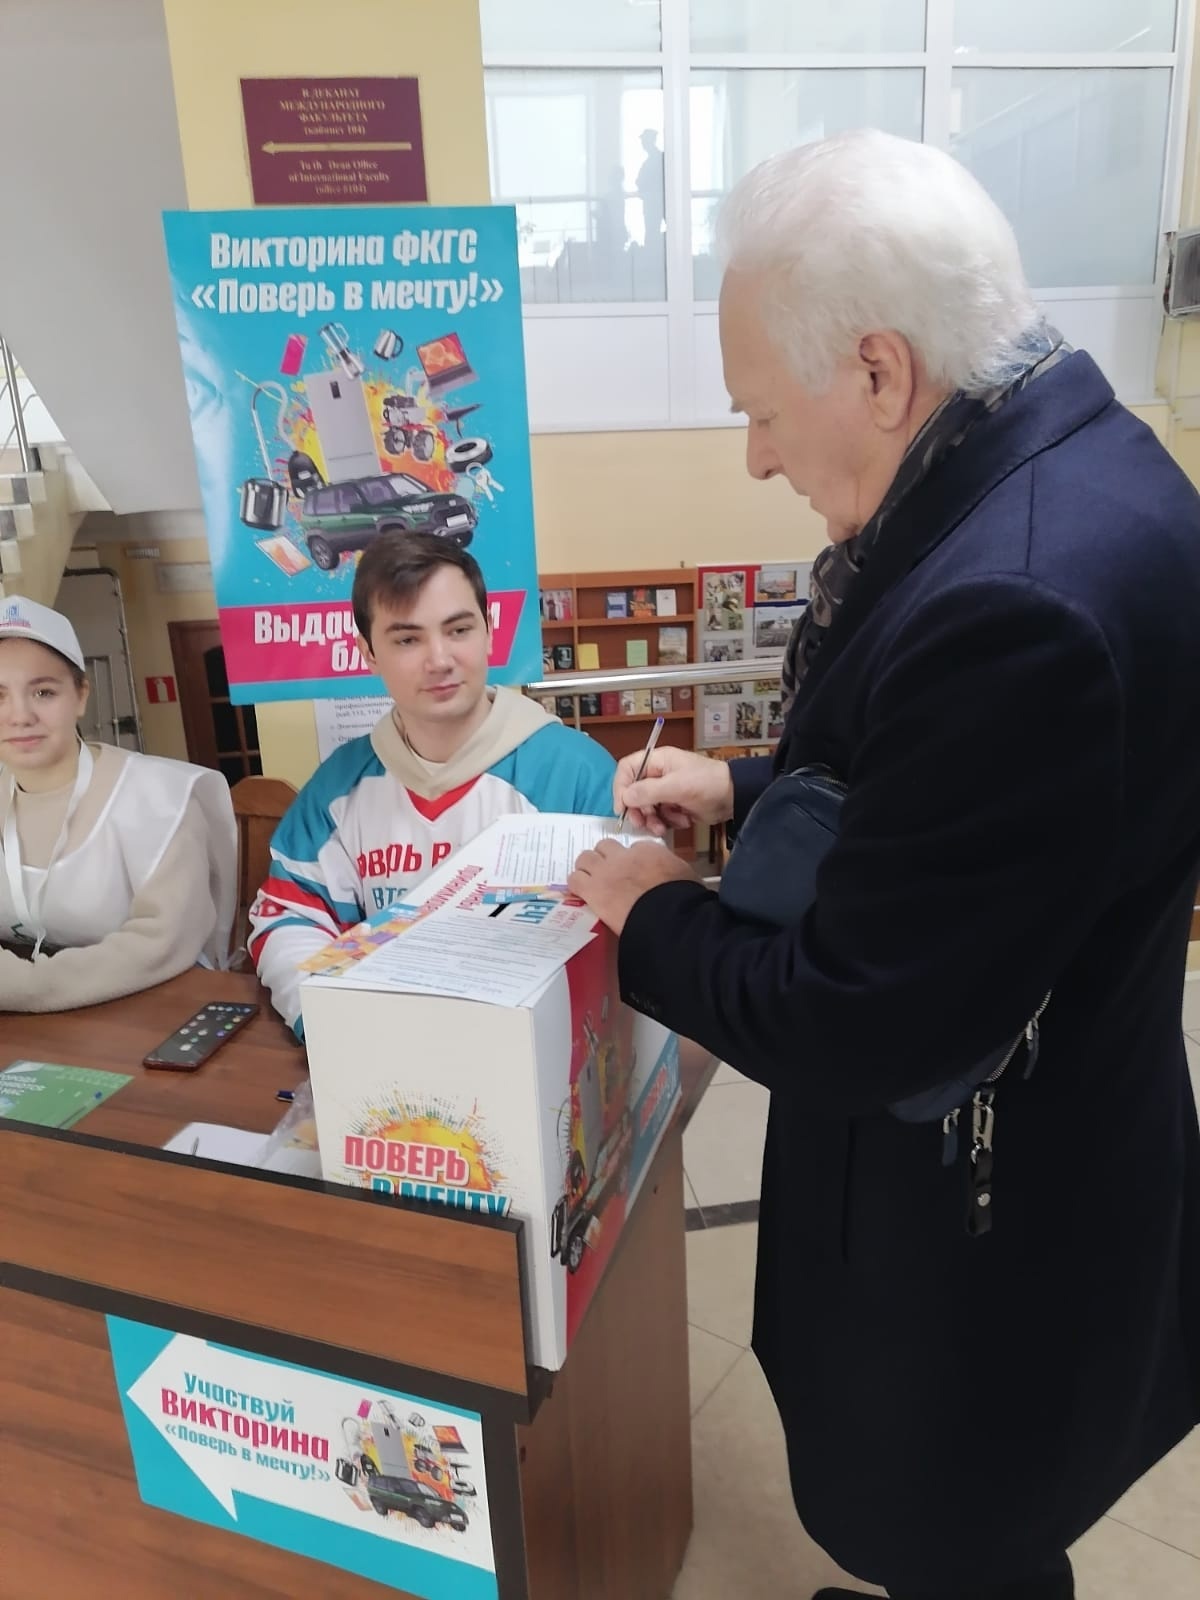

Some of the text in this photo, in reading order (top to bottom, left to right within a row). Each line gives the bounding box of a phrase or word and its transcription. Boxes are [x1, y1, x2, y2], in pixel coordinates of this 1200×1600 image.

[280, 100, 385, 111] МЕЖДУНАРОДНОГО
[312, 88, 359, 98] ДЕКАНАТ
[299, 113, 368, 122] ФАКУЛЬТЕТА
[299, 172, 356, 182] International
[358, 172, 389, 182] Faculty
[328, 160, 352, 170] Dean
[210, 229, 477, 272] Викторина ФКГС
[191, 272, 503, 317] «Поверь в мечту!»
[254, 610, 360, 647] Выдач
[344, 1135, 468, 1183] ПОВЕРЬ
[184, 1371, 295, 1425] Участвуй
[161, 1387, 330, 1463] Викторина
[165, 1423, 331, 1482] «Поверь в мечту!»
